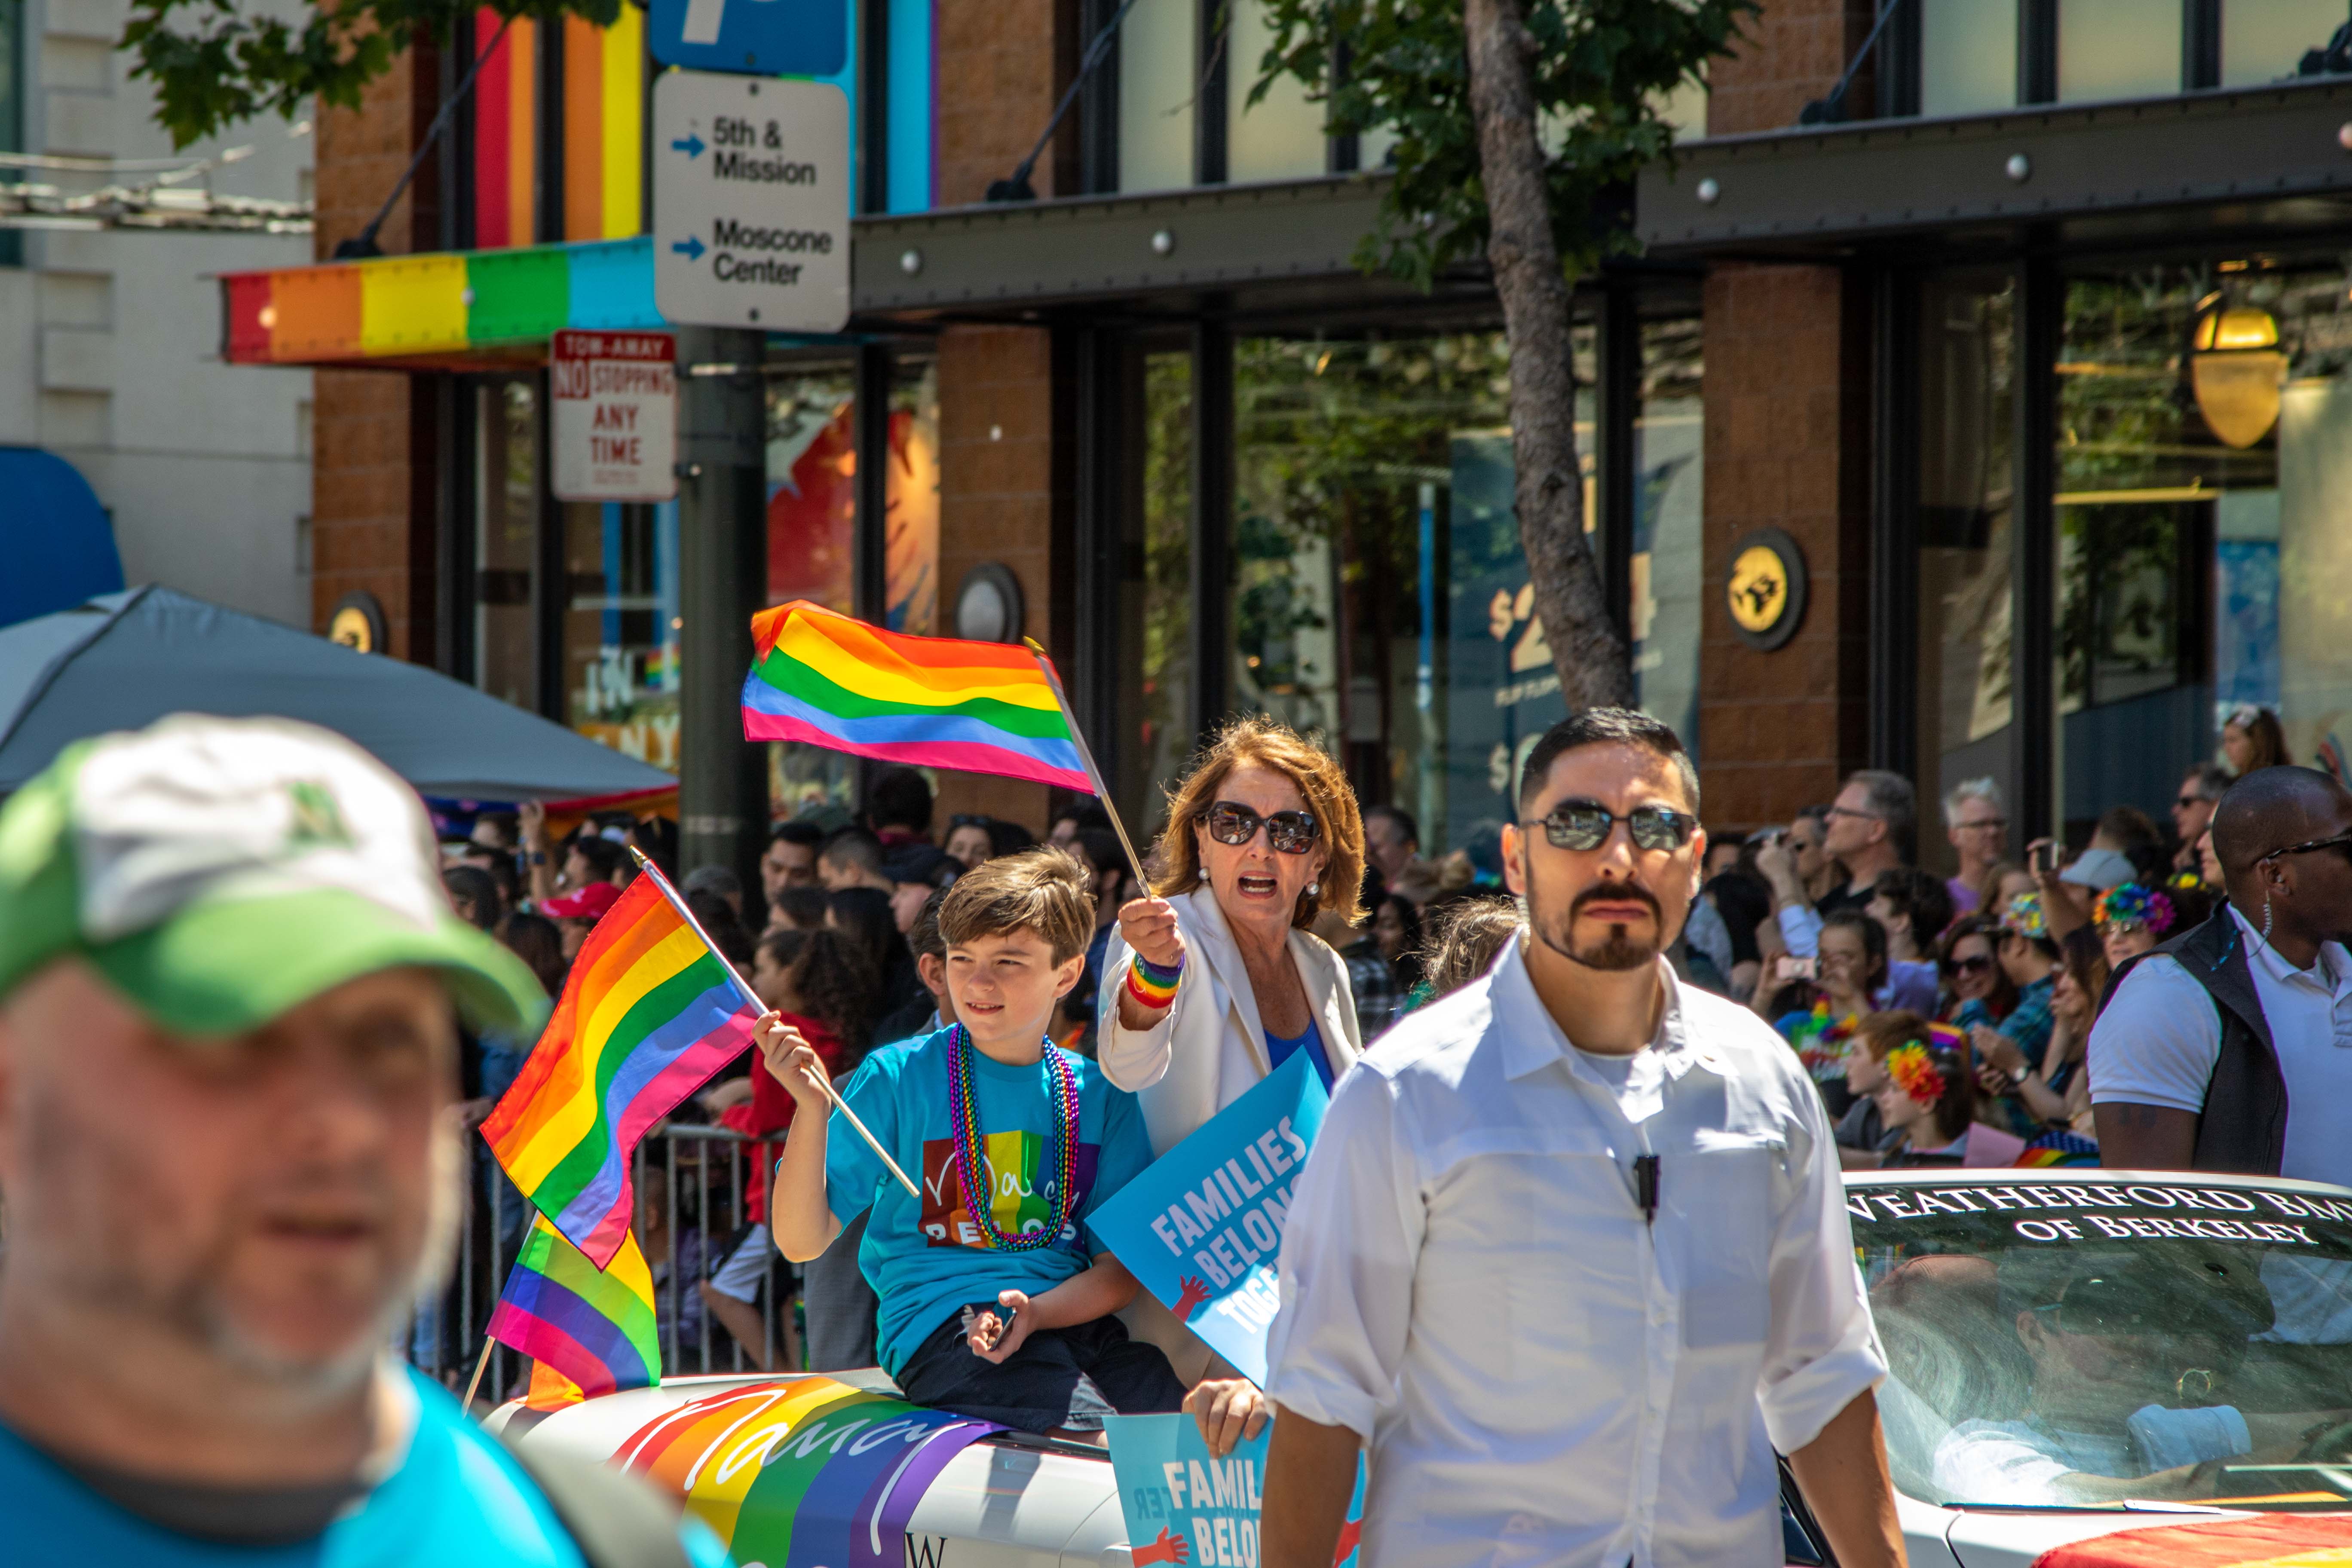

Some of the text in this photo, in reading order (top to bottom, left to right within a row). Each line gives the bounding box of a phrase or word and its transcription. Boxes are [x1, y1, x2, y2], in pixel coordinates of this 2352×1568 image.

[714, 116, 783, 149] 5th &
[714, 151, 816, 185] Mission
[714, 218, 832, 254] Moscone
[713, 253, 802, 285] Center
[565, 334, 665, 356] TOW-AWAY
[556, 360, 586, 395] NO
[593, 404, 639, 429] ANY
[590, 436, 642, 466] TIME
[1150, 1115, 1307, 1257] FAMILIES
[2251, 1190, 2352, 1222] BM
[2016, 1215, 2320, 1245] OF BERKELEY
[1216, 1256, 1281, 1335] TOGE
[1191, 1516, 1262, 1568] BELO
